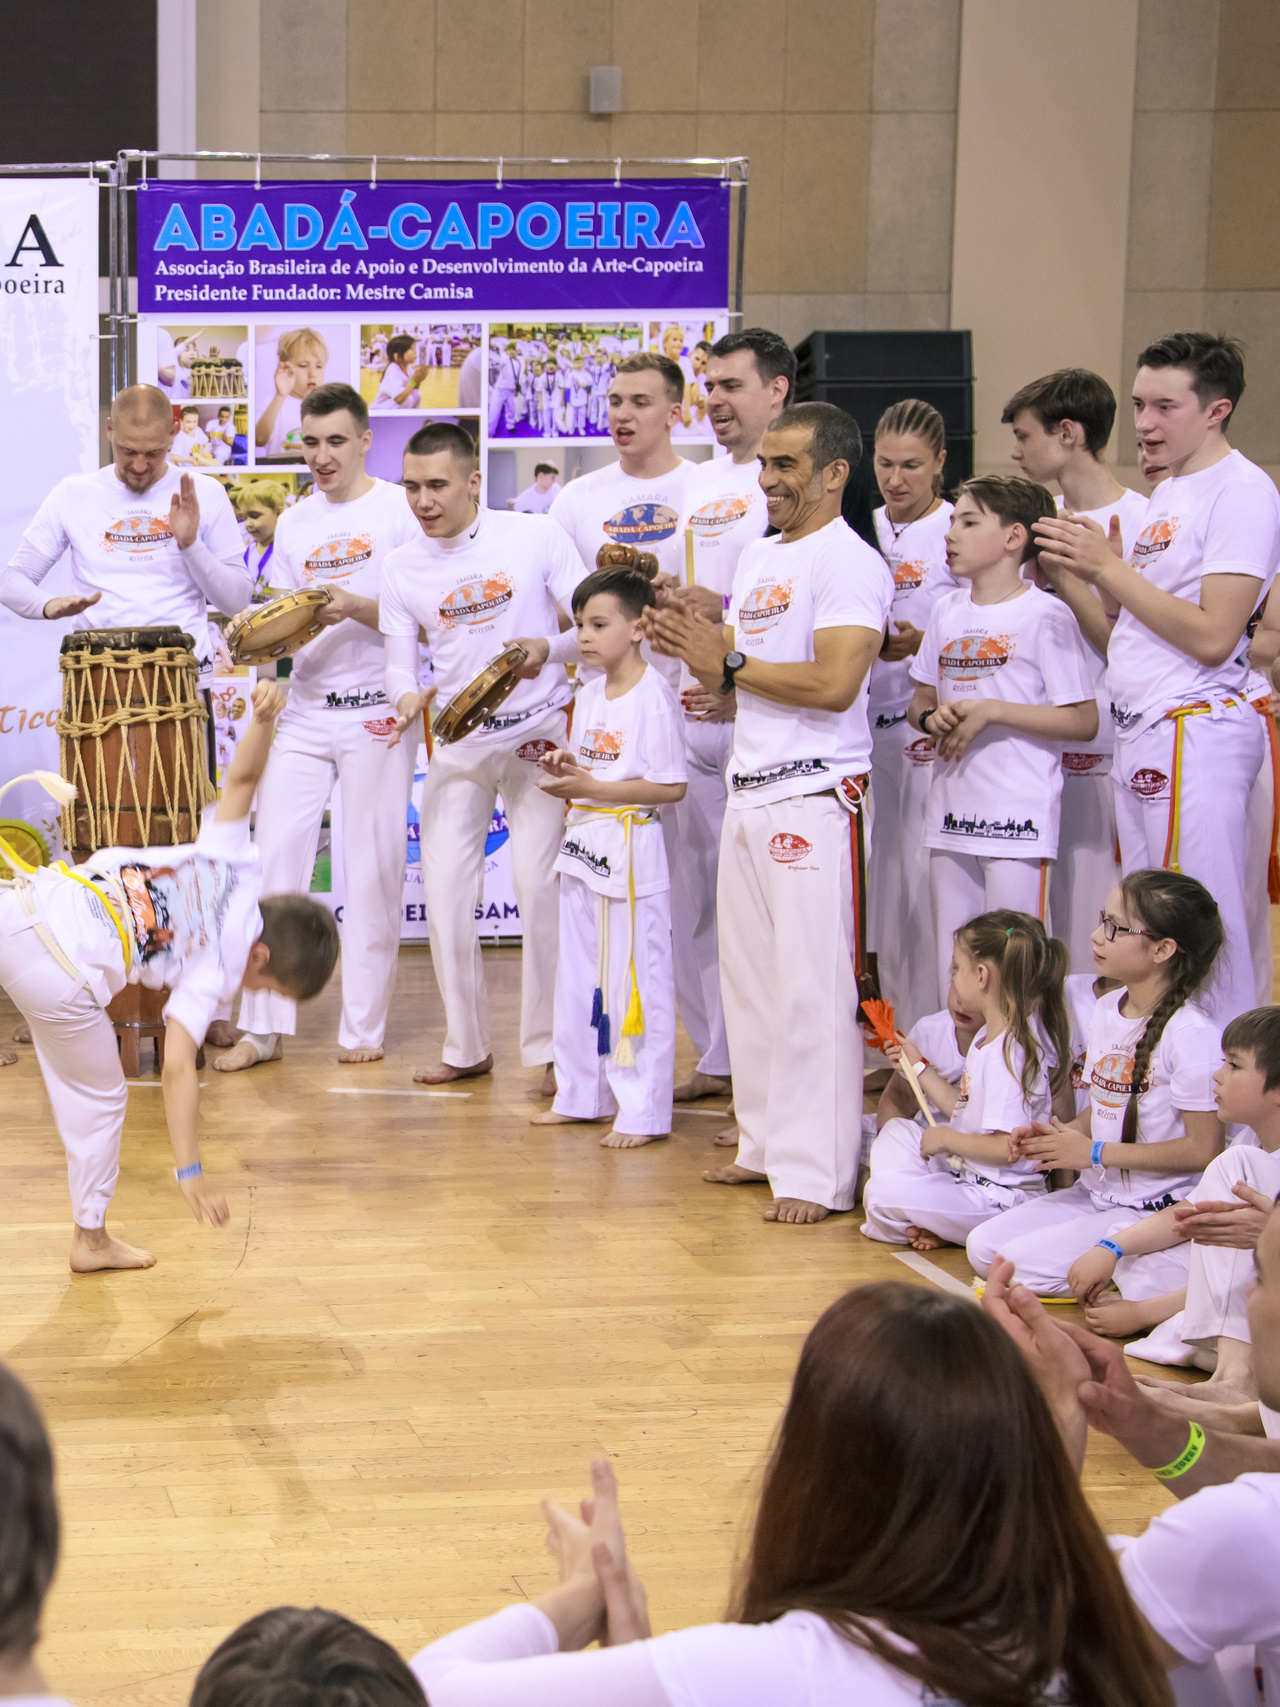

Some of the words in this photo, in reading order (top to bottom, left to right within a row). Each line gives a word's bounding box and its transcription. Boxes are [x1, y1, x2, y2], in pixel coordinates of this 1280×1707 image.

[154, 189, 705, 251] ABADÁ-CAPOEIRA
[154, 259, 245, 279] Associação
[249, 259, 326, 276] Brasileira
[331, 259, 351, 275] de
[355, 258, 405, 279] Apoio
[409, 263, 419, 274] e
[422, 257, 564, 274] Desenvolvimento
[568, 257, 588, 273] da
[592, 256, 704, 277] Arte-Capoeira
[154, 284, 248, 301] Presidente
[252, 284, 341, 301] Fundador:
[346, 284, 406, 301] Mestre
[410, 282, 474, 300] Camisa
